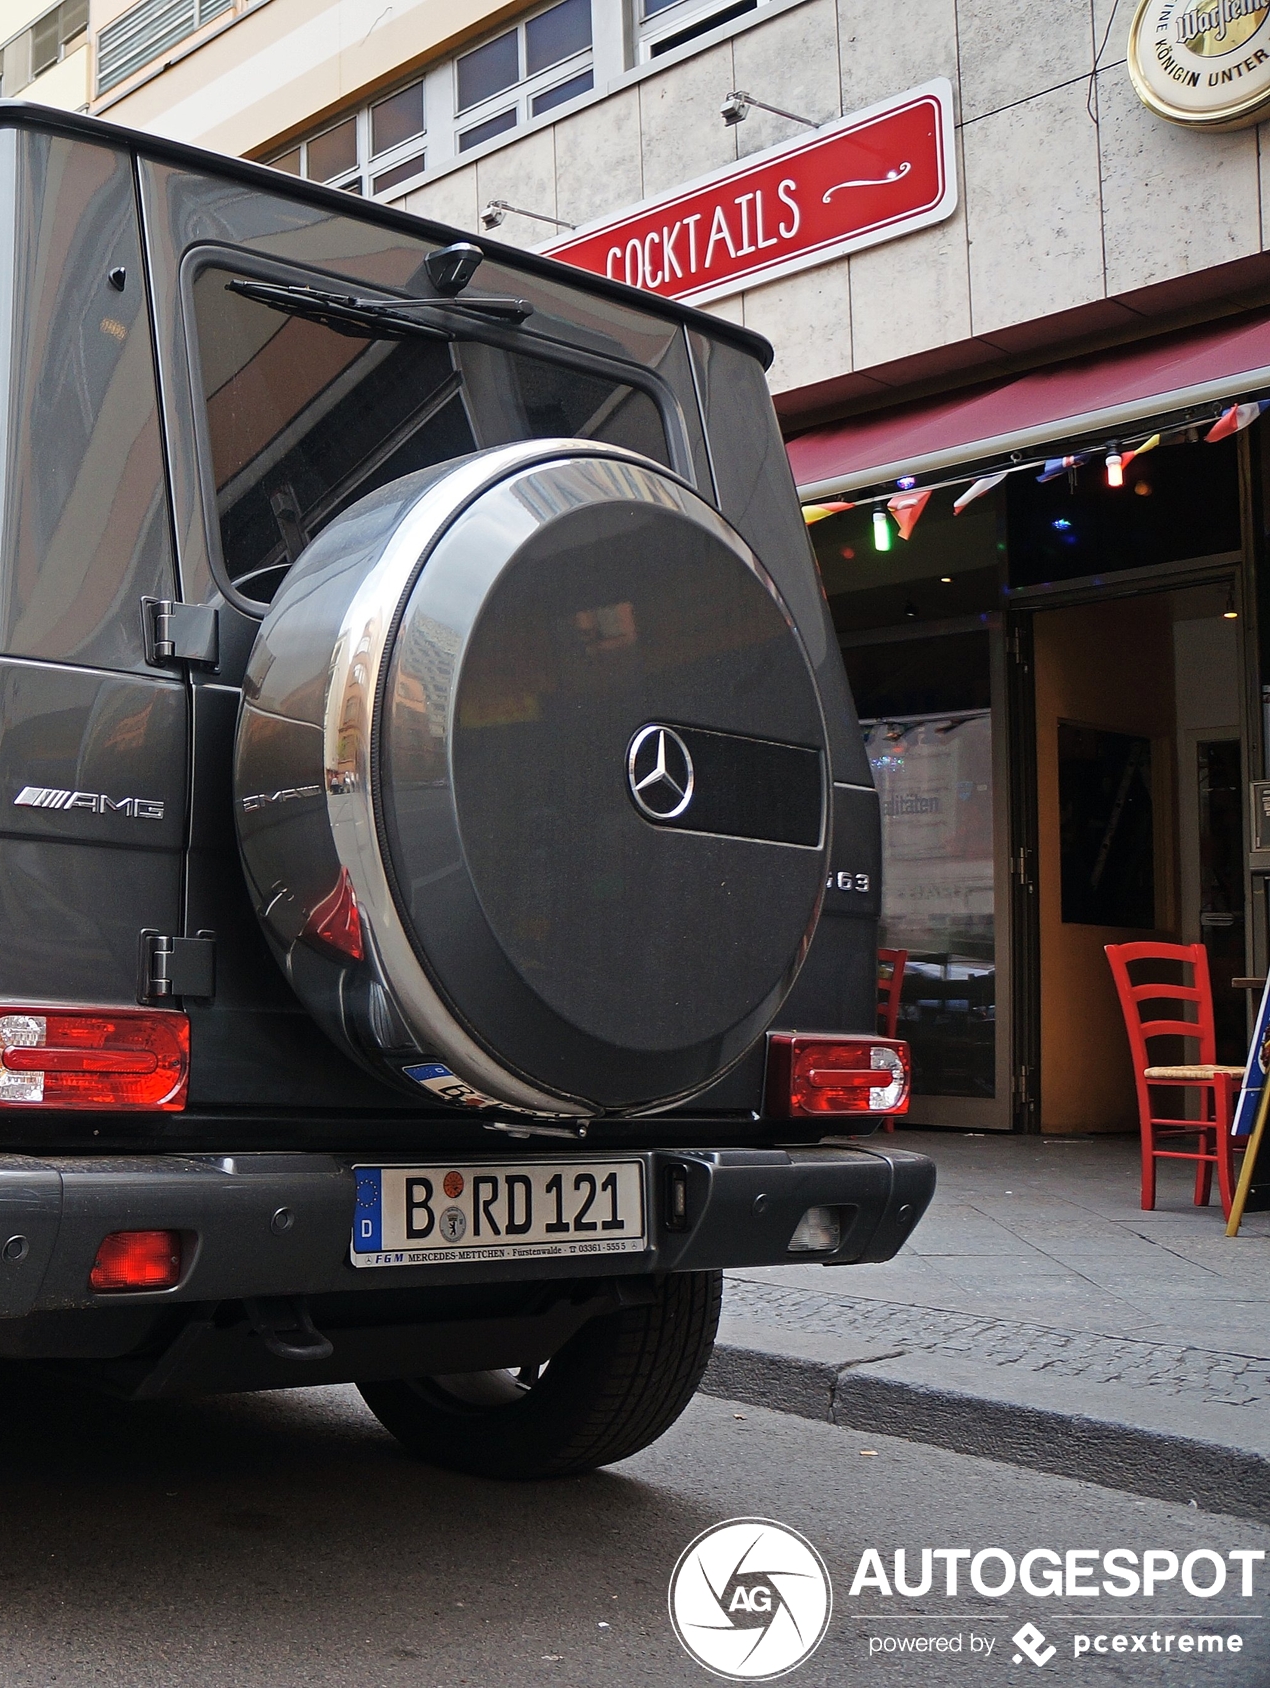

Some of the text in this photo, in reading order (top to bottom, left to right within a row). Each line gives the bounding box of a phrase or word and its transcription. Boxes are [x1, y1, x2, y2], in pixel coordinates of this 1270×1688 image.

[1155, 0, 1270, 87] INE KÖNIGIN UNTER
[606, 179, 800, 289] COCKTAILS
[63, 790, 165, 820] AMG
[361, 1219, 372, 1238] D
[405, 1172, 625, 1239] B RD 121
[408, 1248, 506, 1263] MERCEDES-METTCHEN
